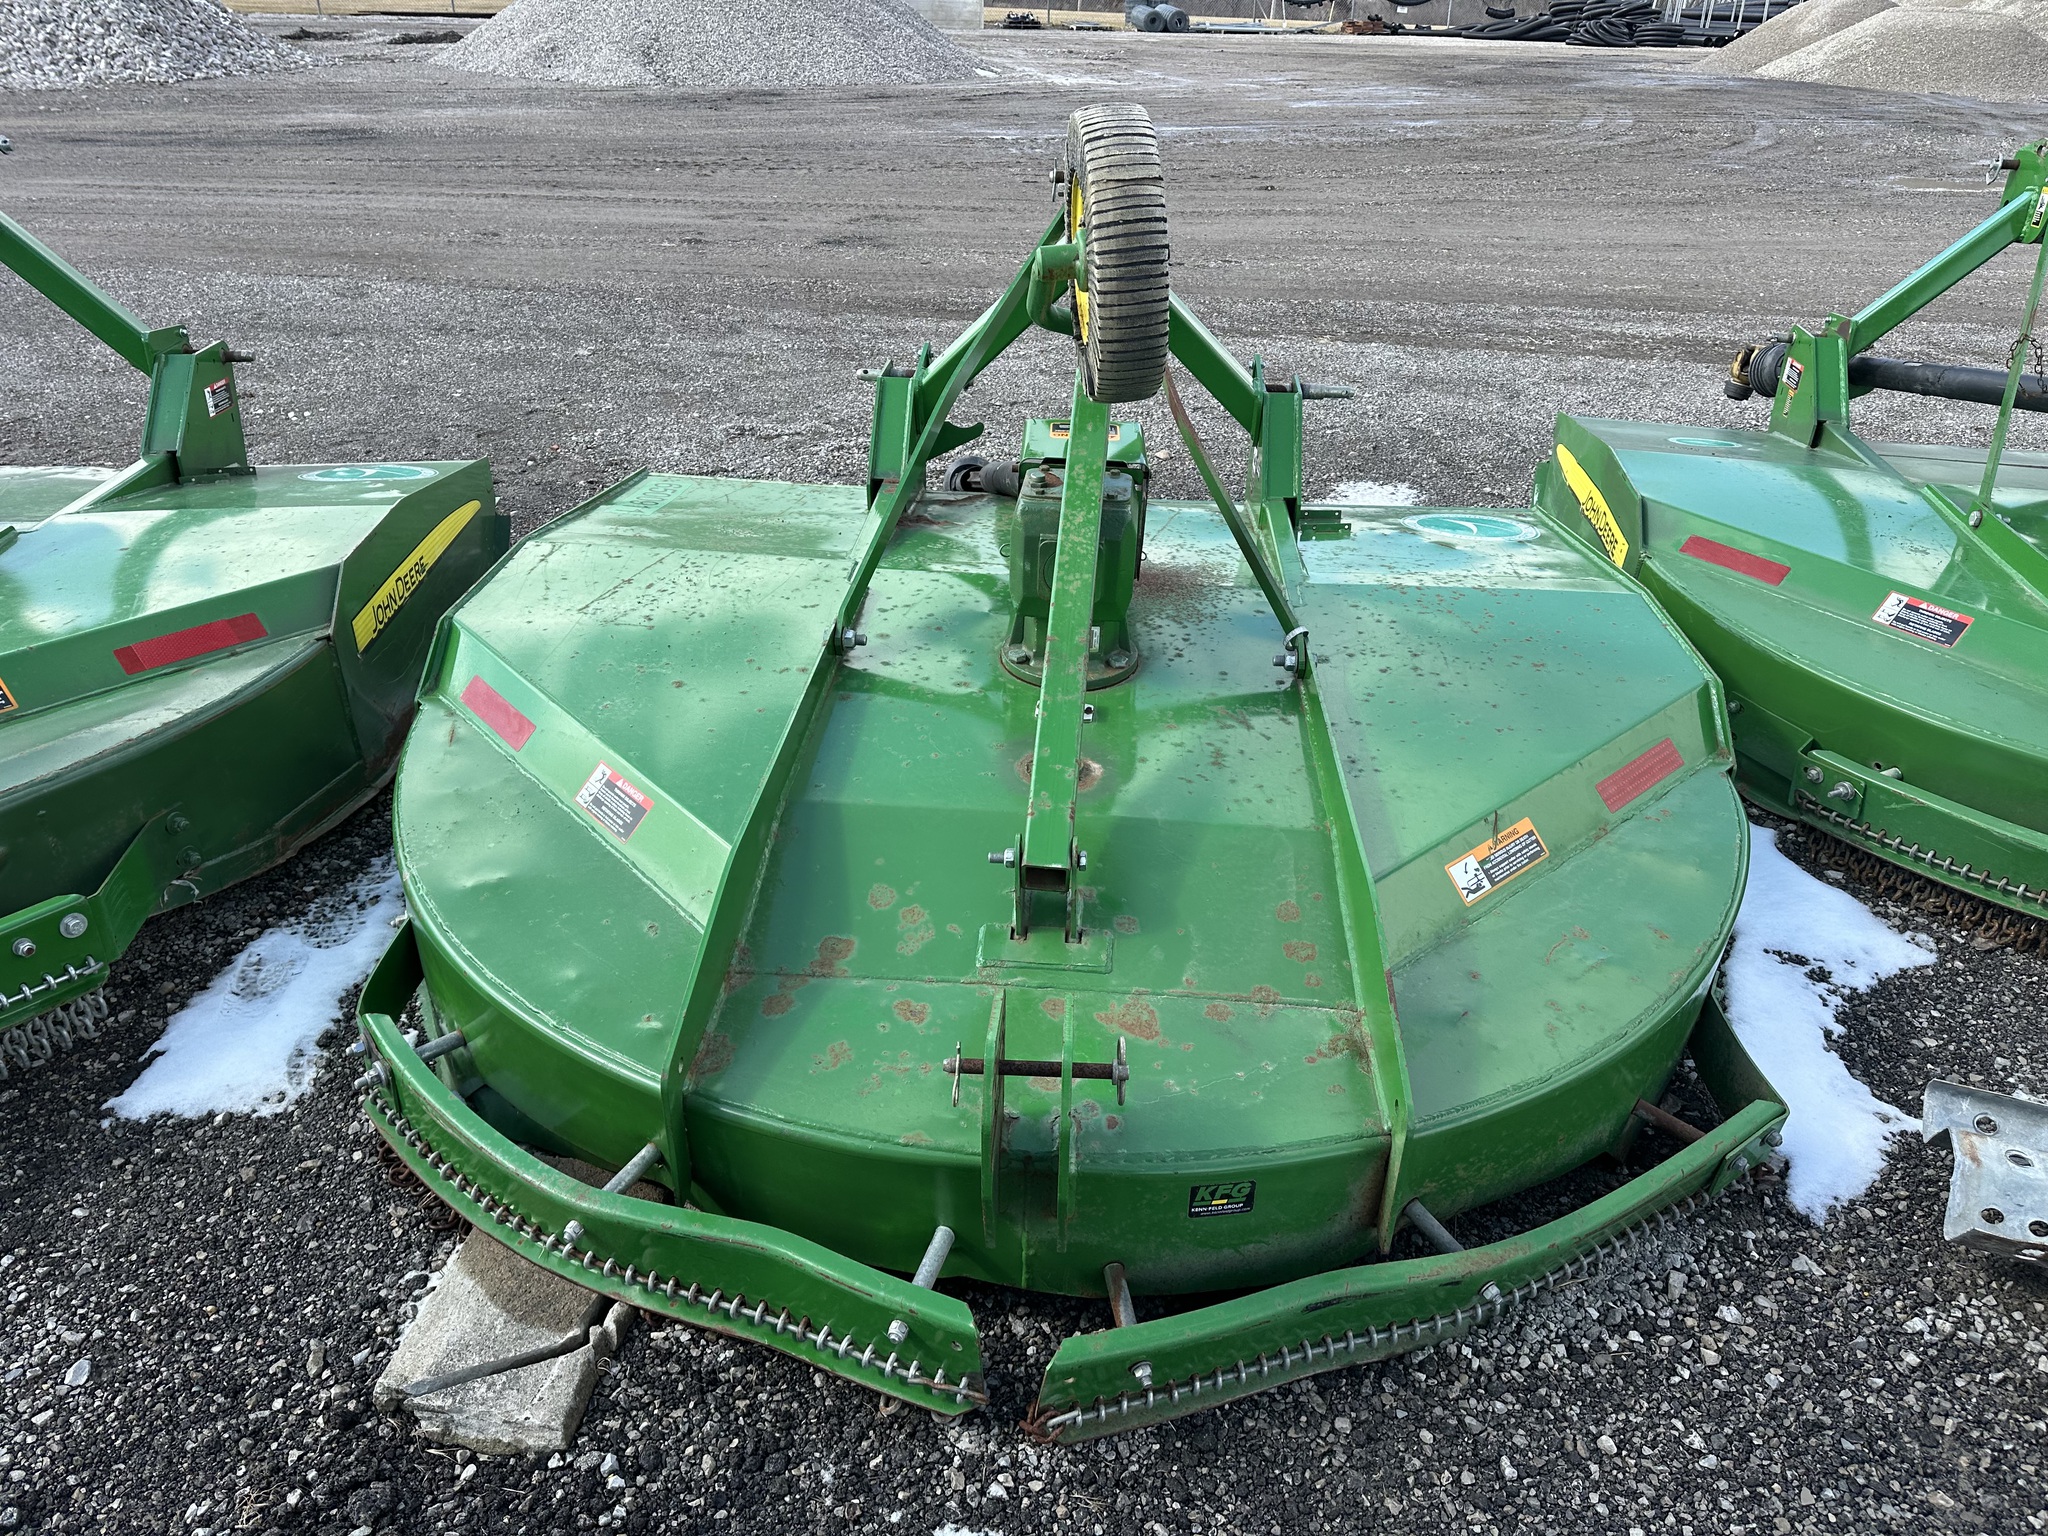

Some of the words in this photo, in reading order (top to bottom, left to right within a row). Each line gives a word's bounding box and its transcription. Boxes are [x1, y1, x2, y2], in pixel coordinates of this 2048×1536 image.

[1582, 490, 1602, 527] JOHN
[1598, 510, 1619, 558] DEERE
[372, 588, 398, 634] JOHN
[395, 555, 429, 600] DEERE
[1928, 605, 1959, 620] DANGER
[621, 782, 645, 803] DANGER
[1194, 1182, 1252, 1202] KFG
